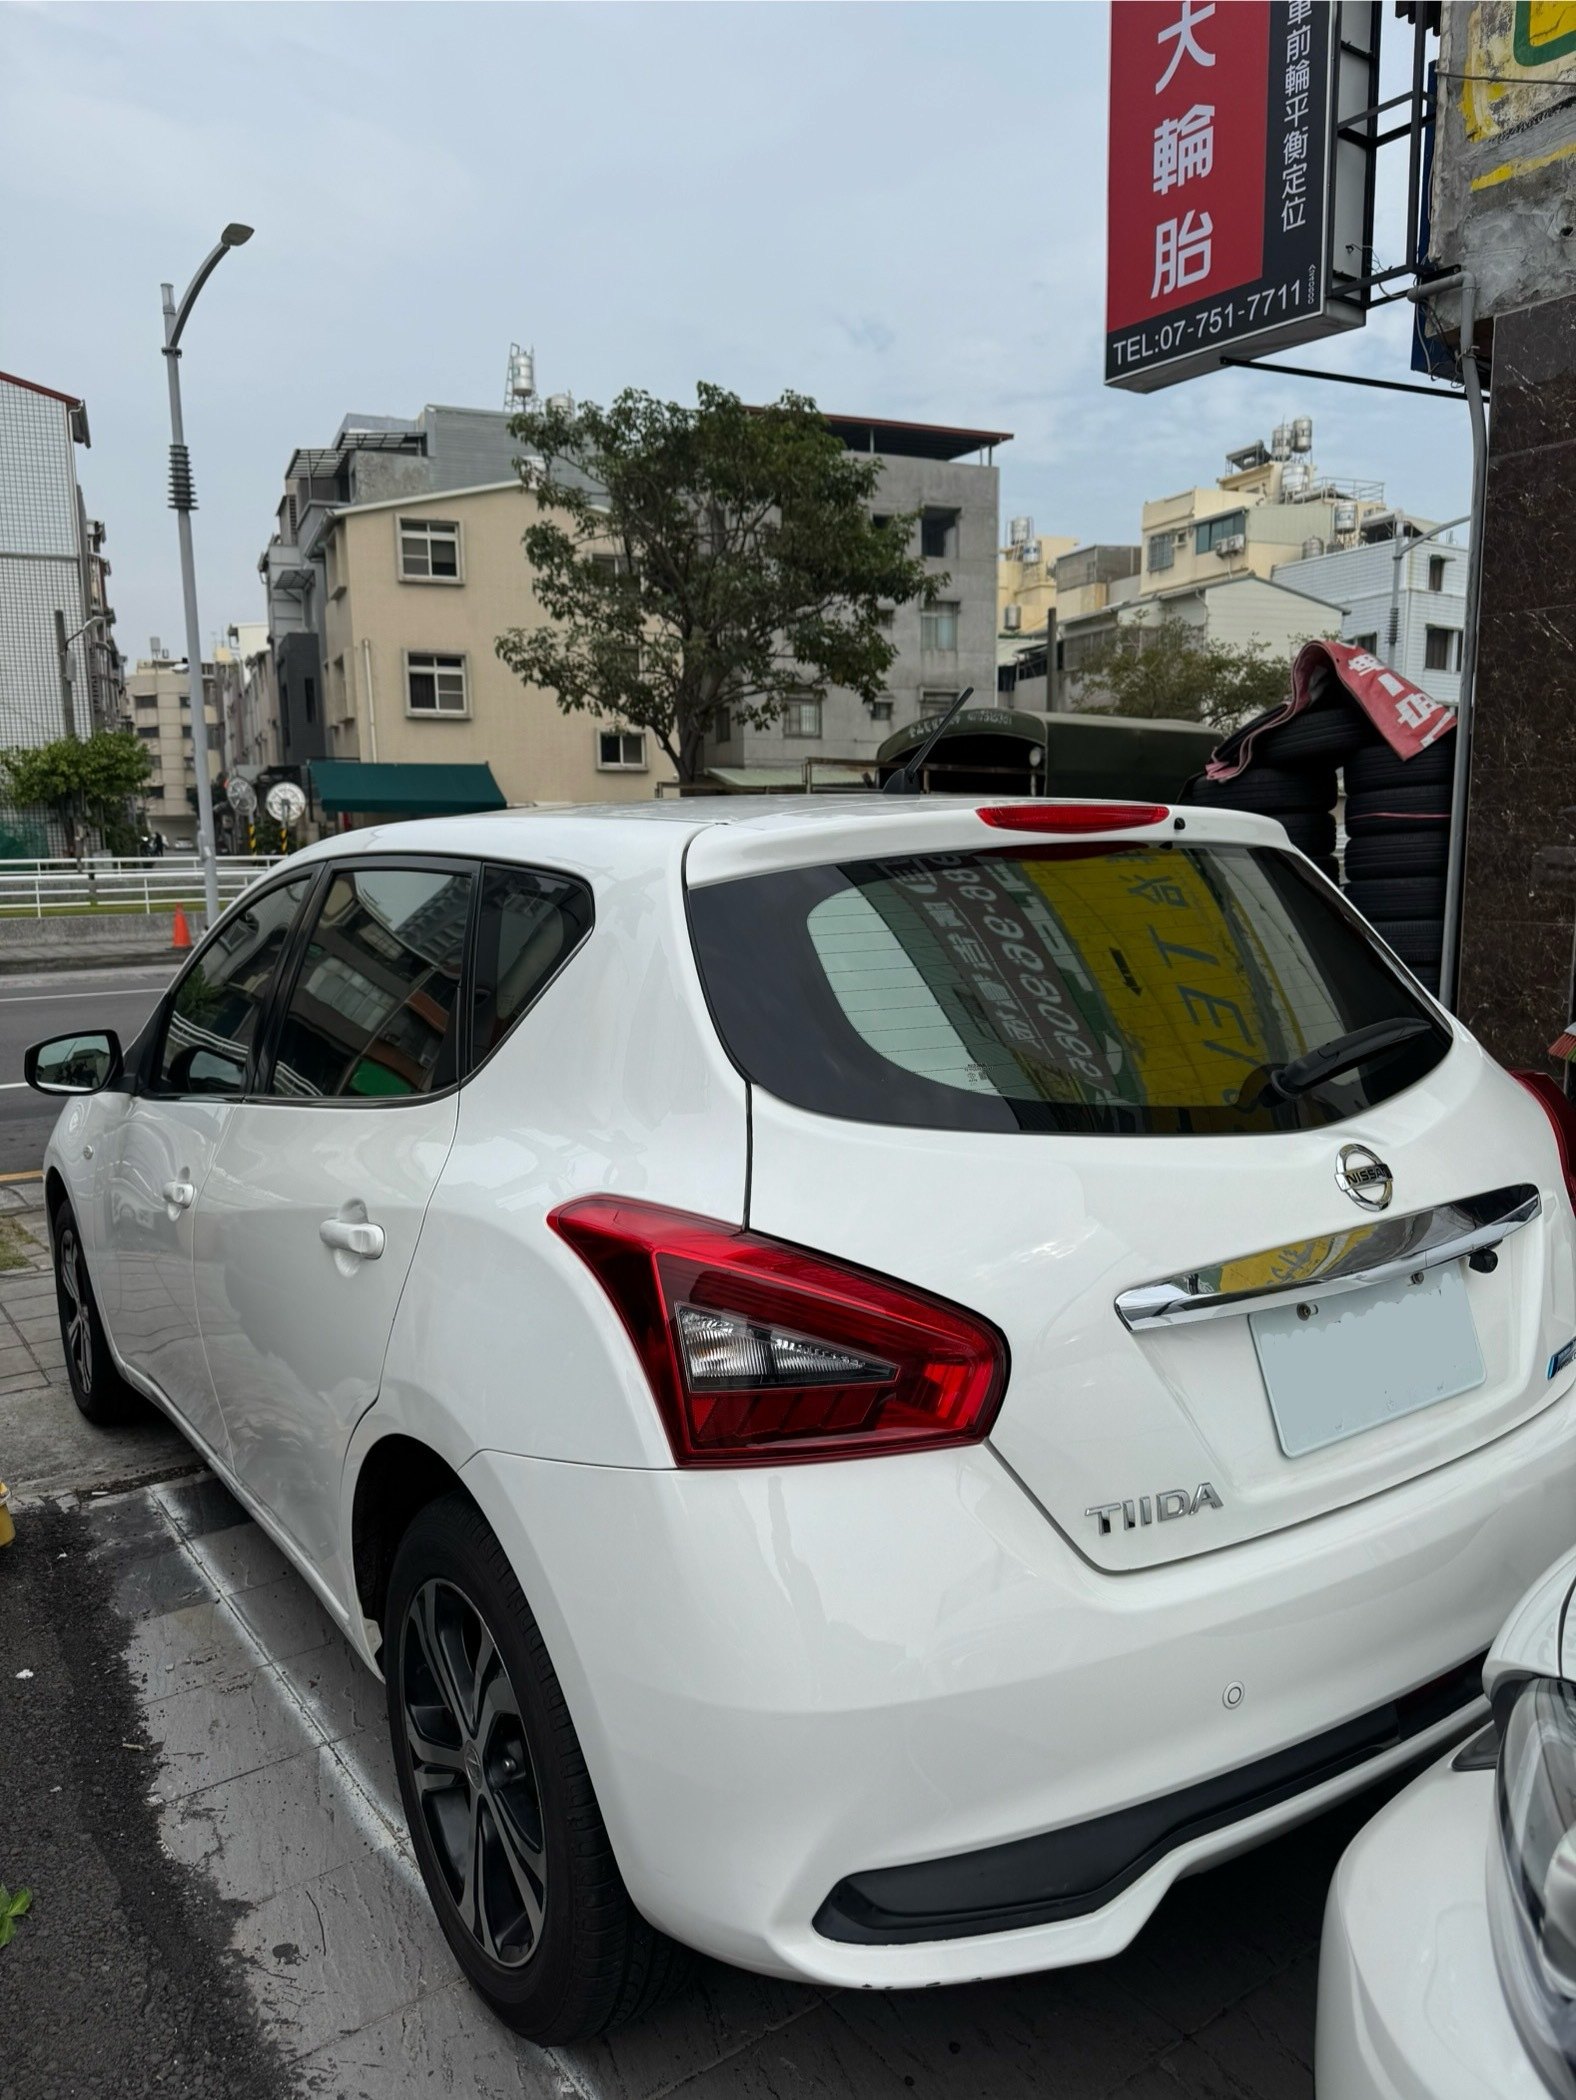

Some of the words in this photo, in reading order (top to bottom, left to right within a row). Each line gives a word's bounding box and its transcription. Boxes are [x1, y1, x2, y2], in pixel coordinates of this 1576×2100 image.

[1150, 0, 1216, 299] 大輪胎
[1113, 279, 1300, 365] TEL:07-751-7711
[1346, 1164, 1389, 1185] NISSA
[1085, 1481, 1224, 1536] TIIDA
